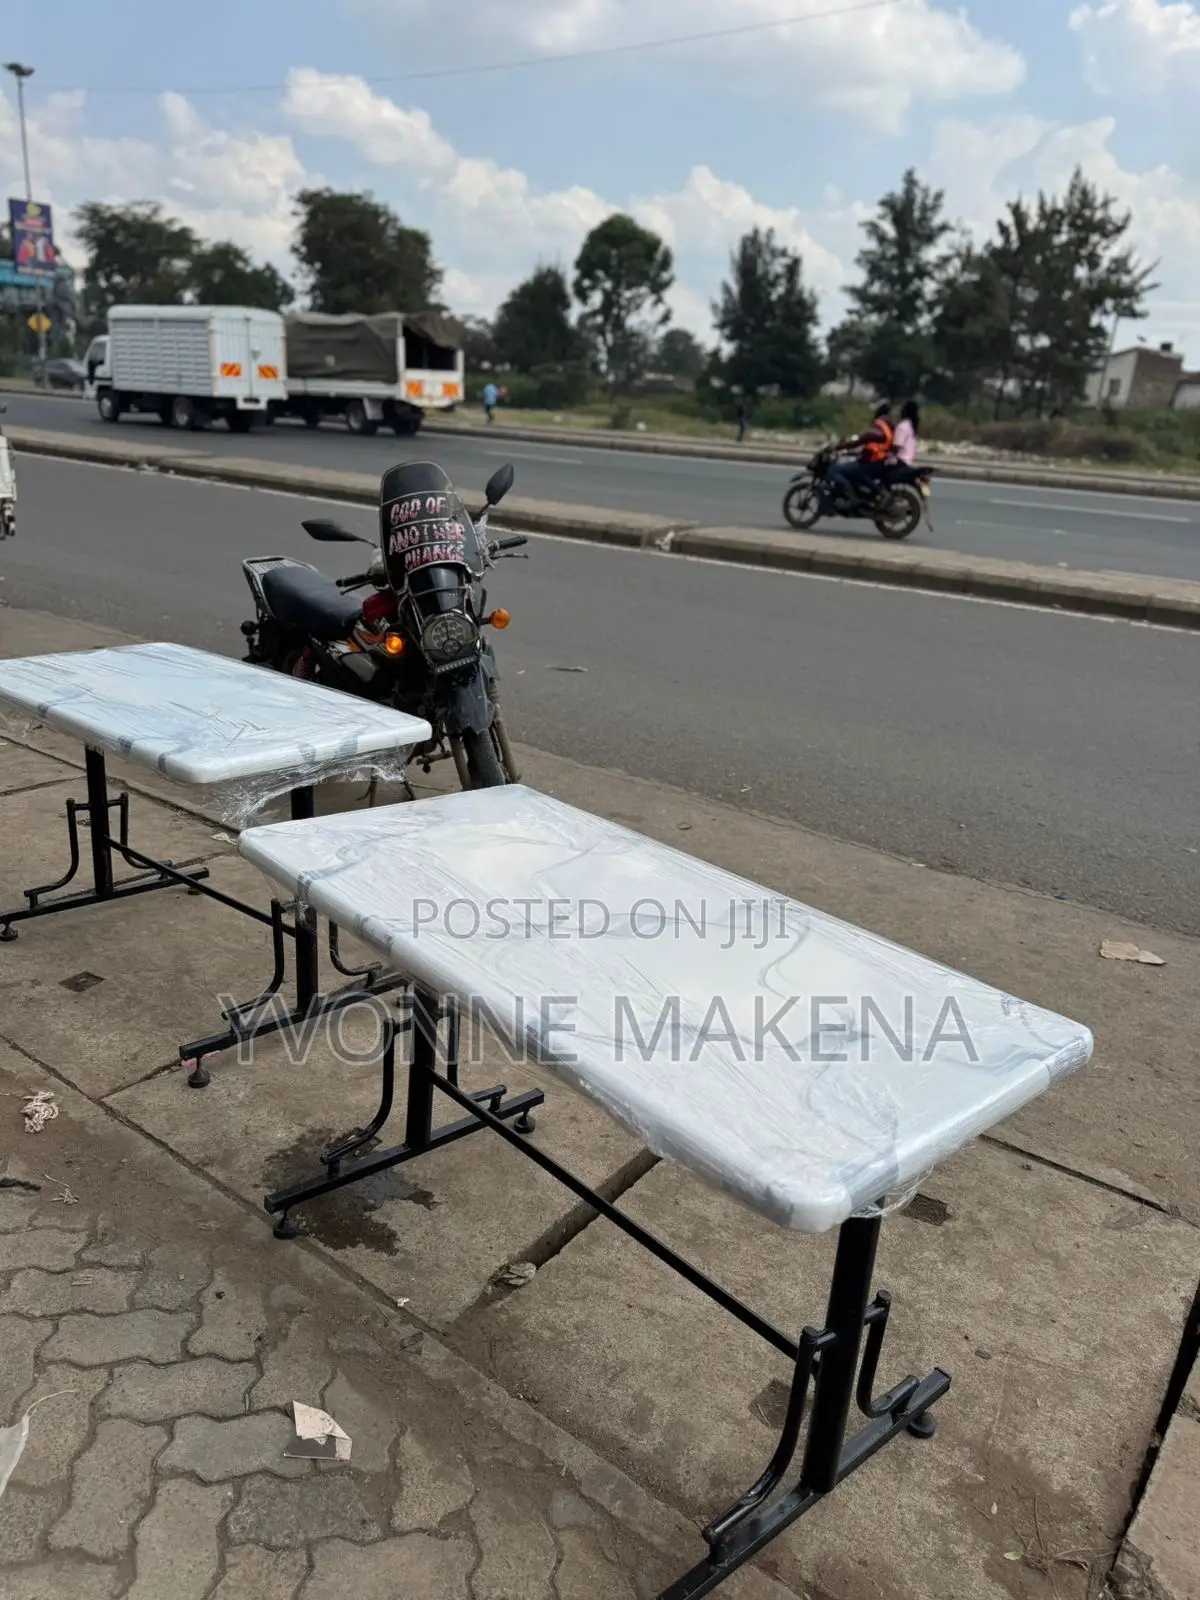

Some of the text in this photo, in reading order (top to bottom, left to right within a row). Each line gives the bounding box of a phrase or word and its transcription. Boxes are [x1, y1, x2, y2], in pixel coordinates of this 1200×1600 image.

[391, 497, 447, 525] GOD OF
[388, 522, 466, 556] ANOTHER
[404, 544, 465, 571] CHANCE
